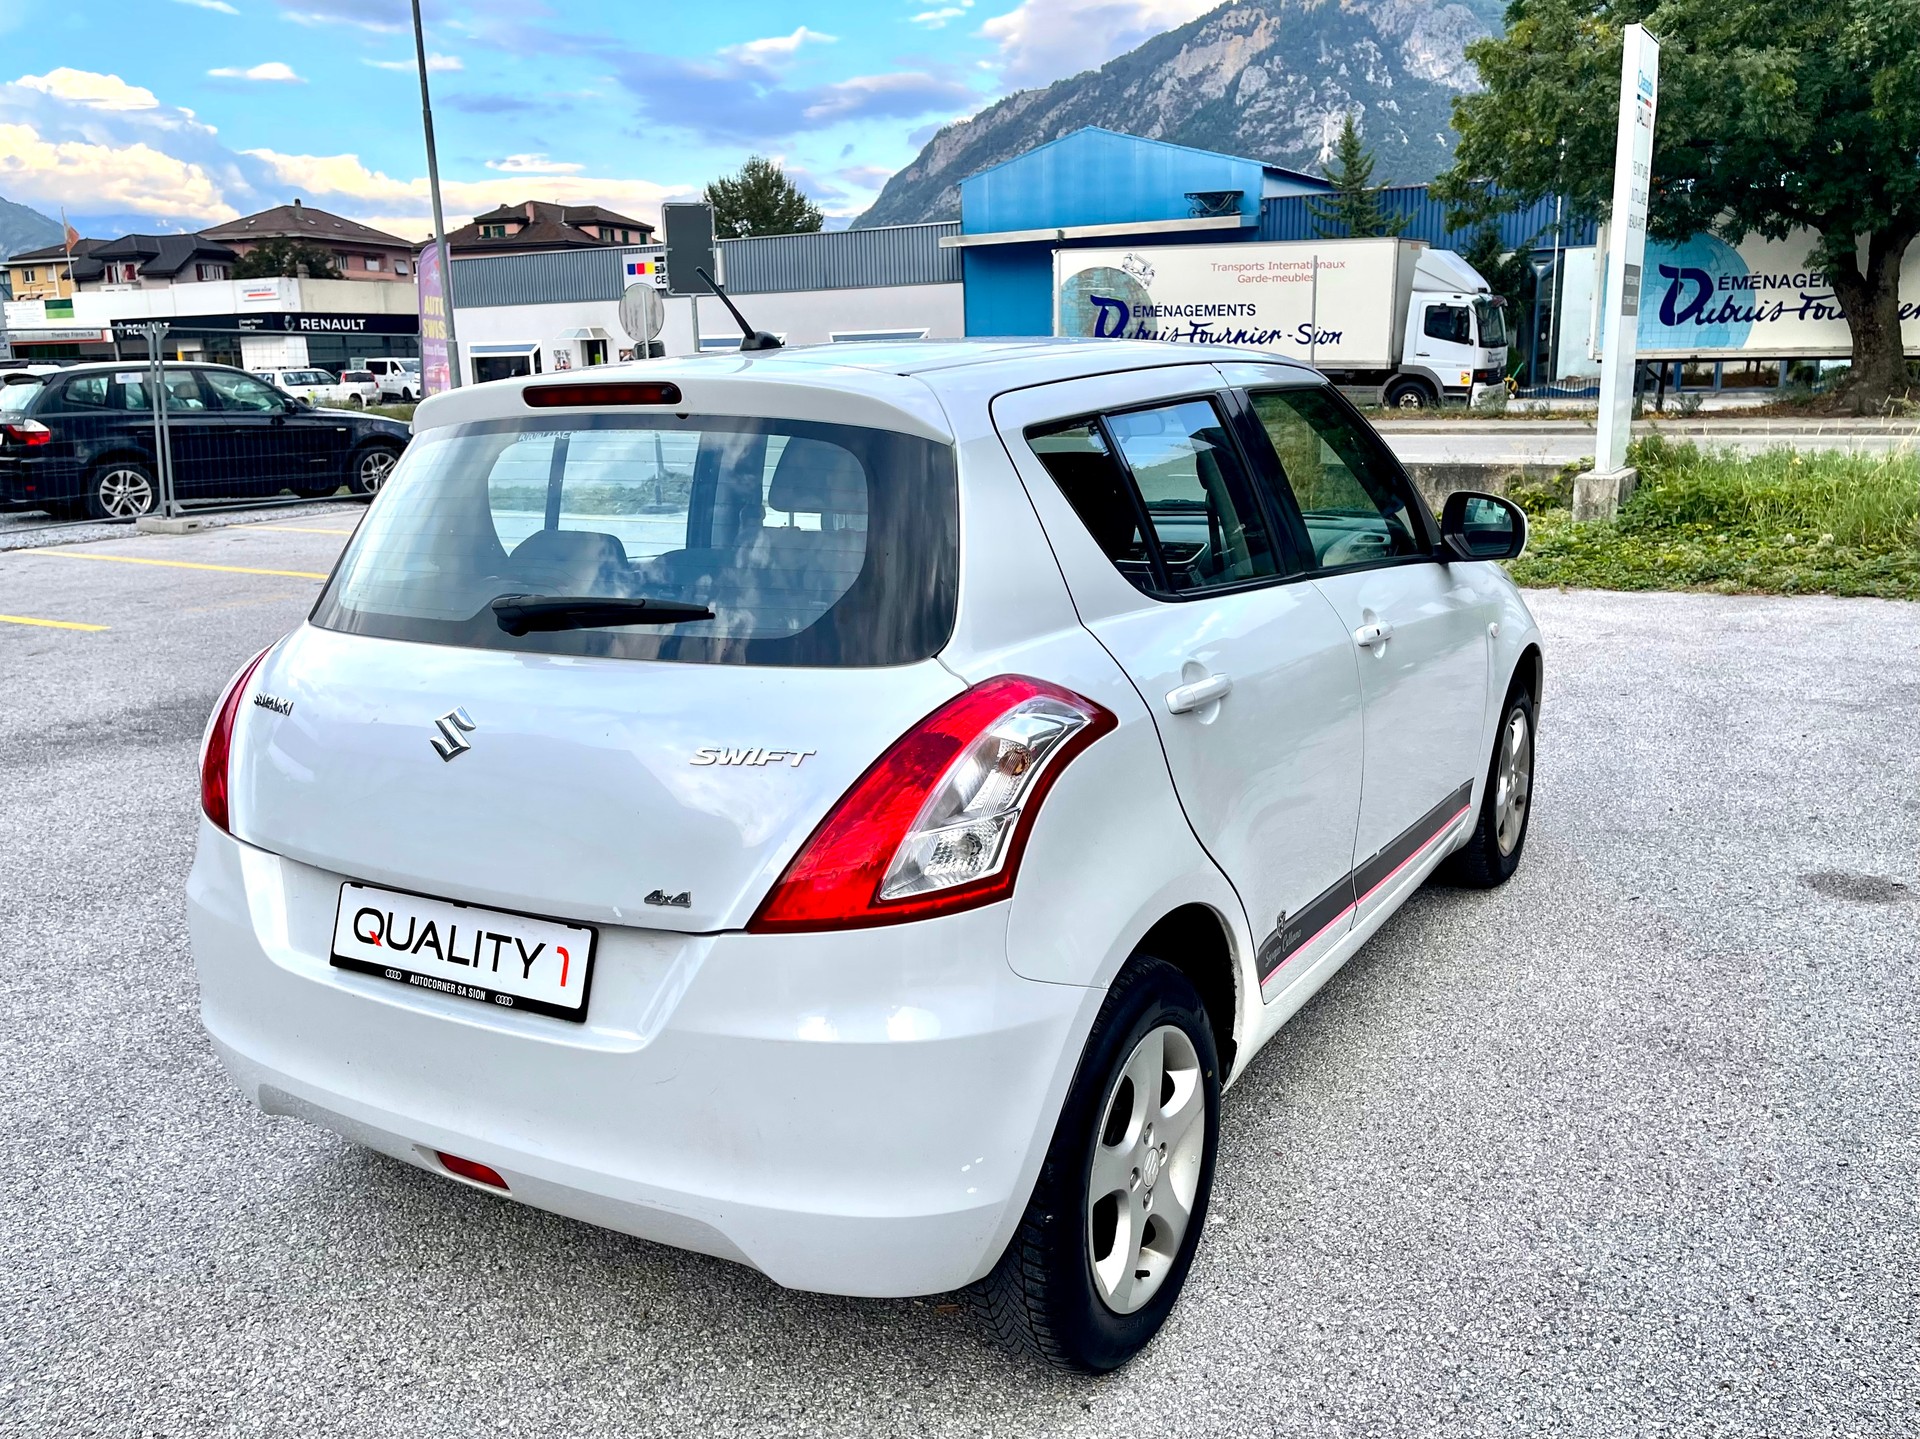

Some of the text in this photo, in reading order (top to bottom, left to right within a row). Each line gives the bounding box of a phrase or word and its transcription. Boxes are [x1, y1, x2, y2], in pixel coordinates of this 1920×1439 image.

[1210, 262, 1265, 272] Transports
[655, 275, 667, 285] CE
[1237, 272, 1315, 284] Garde-meubles
[300, 318, 366, 330] RENAULT
[423, 318, 447, 340] SWIS
[1295, 323, 1342, 345] Sion
[689, 747, 817, 767] SWIFT
[353, 907, 570, 987] QUALITY 1
[410, 974, 486, 1001] AUTOCORNER SA SION
